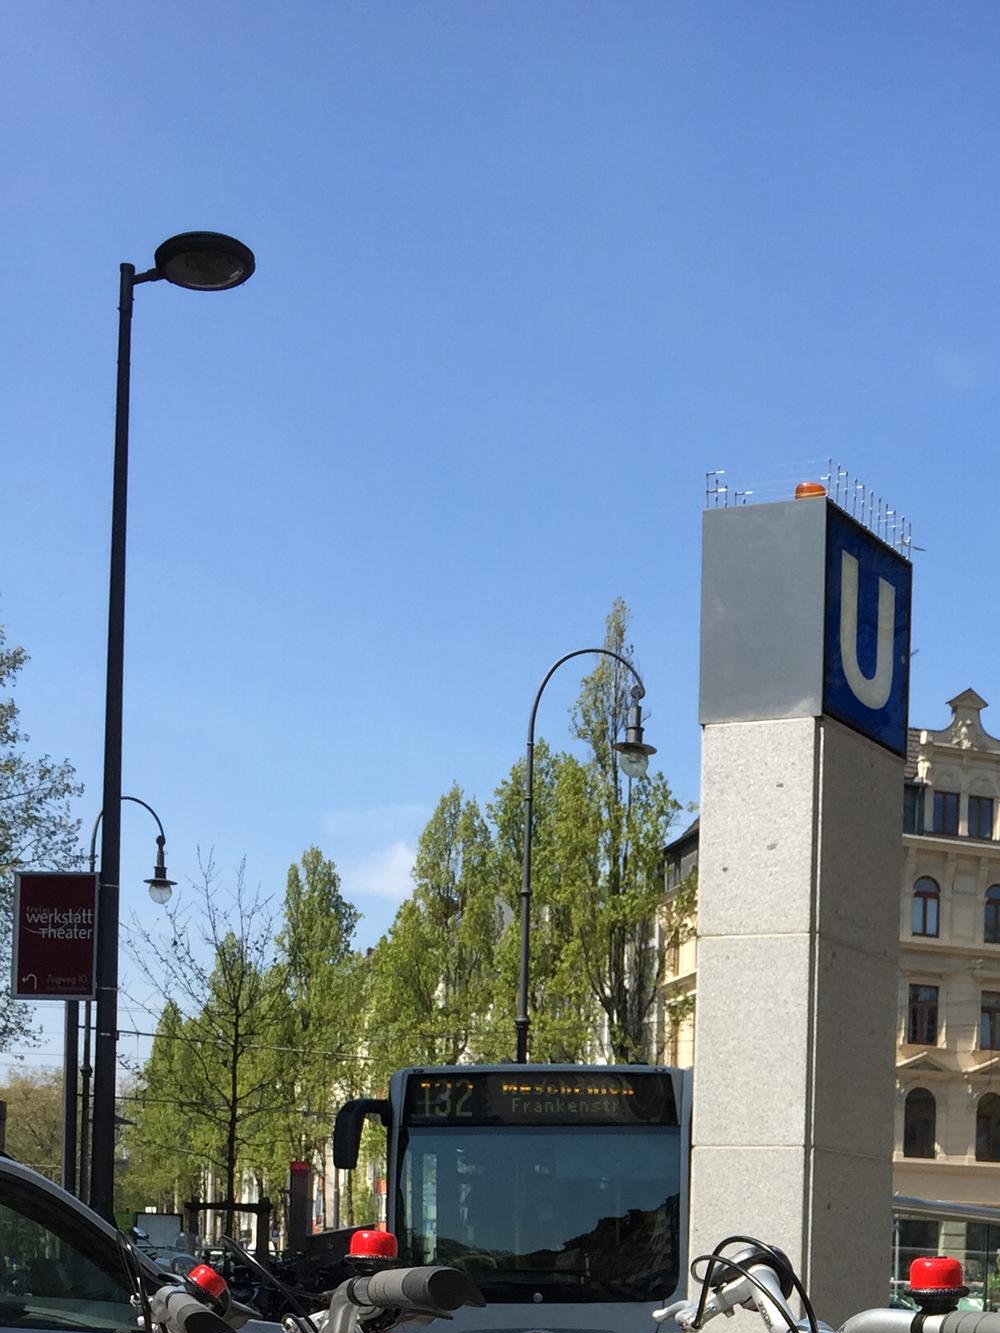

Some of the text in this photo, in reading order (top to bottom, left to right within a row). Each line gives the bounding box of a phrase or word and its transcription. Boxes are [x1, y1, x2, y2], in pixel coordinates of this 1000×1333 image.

[840, 550, 896, 710] U
[26, 907, 93, 924] werkstatt
[39, 924, 93, 939] Theater
